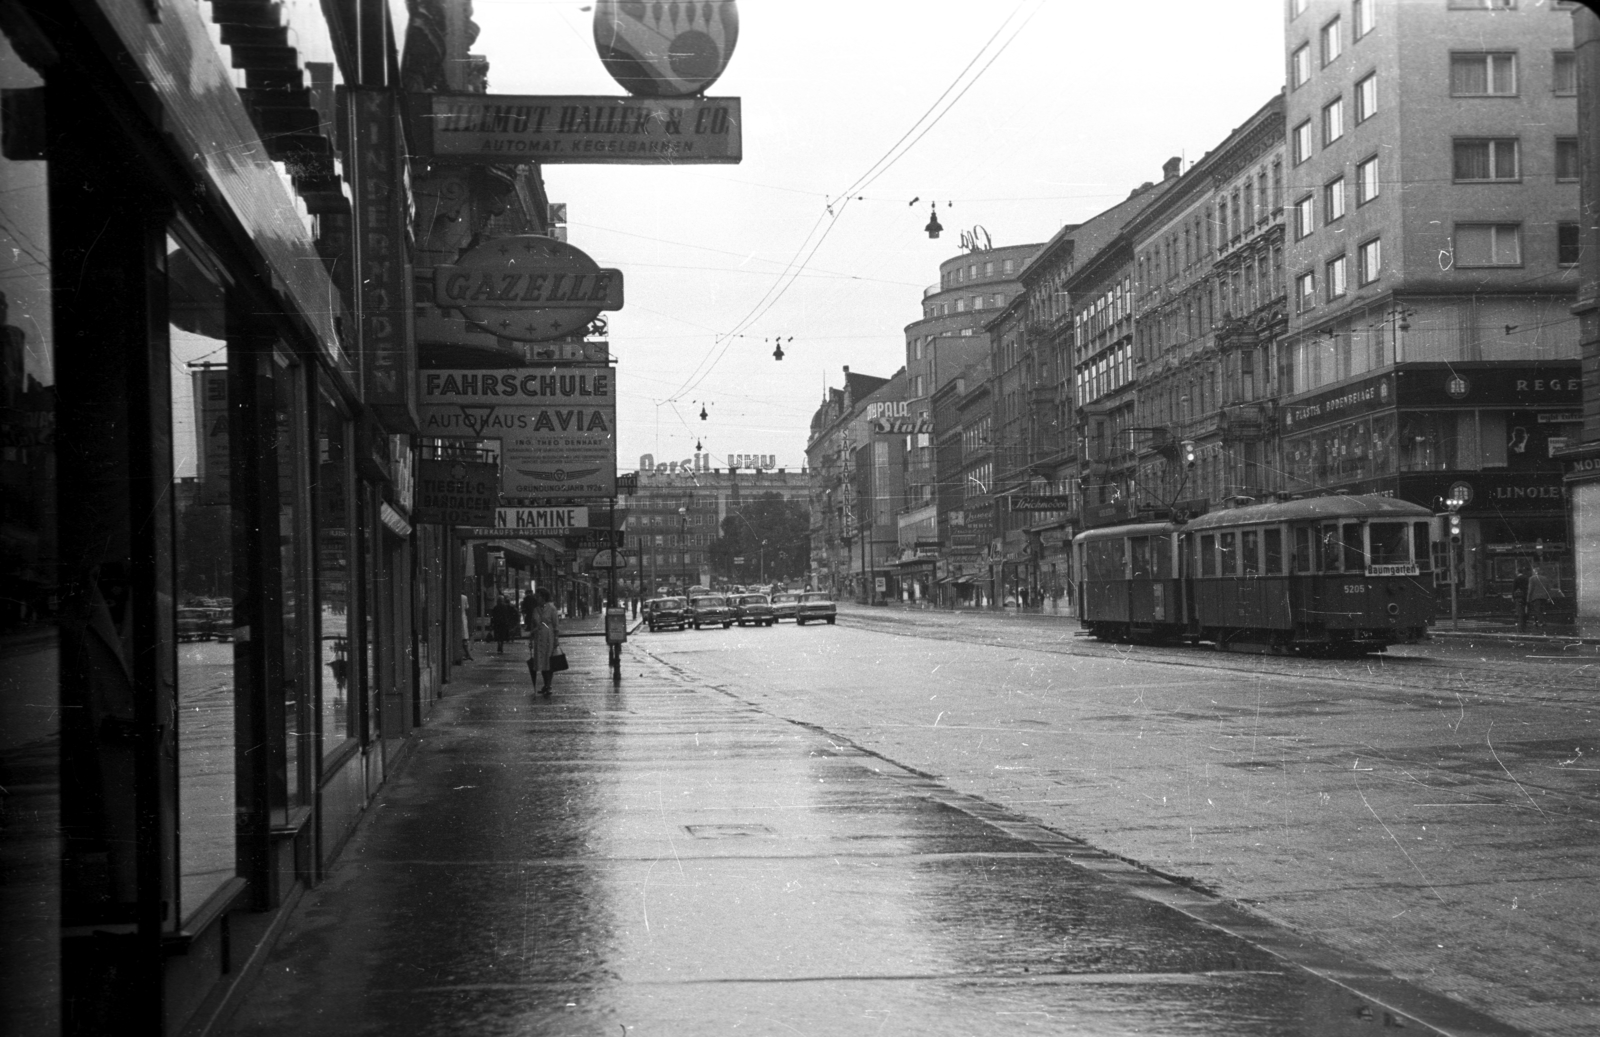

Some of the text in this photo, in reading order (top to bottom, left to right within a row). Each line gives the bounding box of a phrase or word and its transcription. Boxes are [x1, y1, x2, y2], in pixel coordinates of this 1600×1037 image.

[441, 105, 551, 134] HELMUT
[557, 106, 652, 135] HALLER
[665, 107, 682, 135] &
[571, 140, 694, 153] KEGELBAHNEN
[445, 272, 613, 301] GAZELLE
[427, 374, 608, 397] FAHRSCHULE
[1516, 379, 1578, 391] REGE
[428, 410, 608, 432] AUTOHAUS AVIA
[1295, 404, 1321, 421] PLASTIK
[874, 417, 934, 434] Stafa
[639, 452, 776, 476] Persil UHU
[840, 428, 852, 538] SALAMANDER
[516, 509, 575, 528] KAMINE
[1177, 509, 1190, 521] 52
[1367, 564, 1417, 575] Baumgarten
[1344, 584, 1365, 593] 5205
